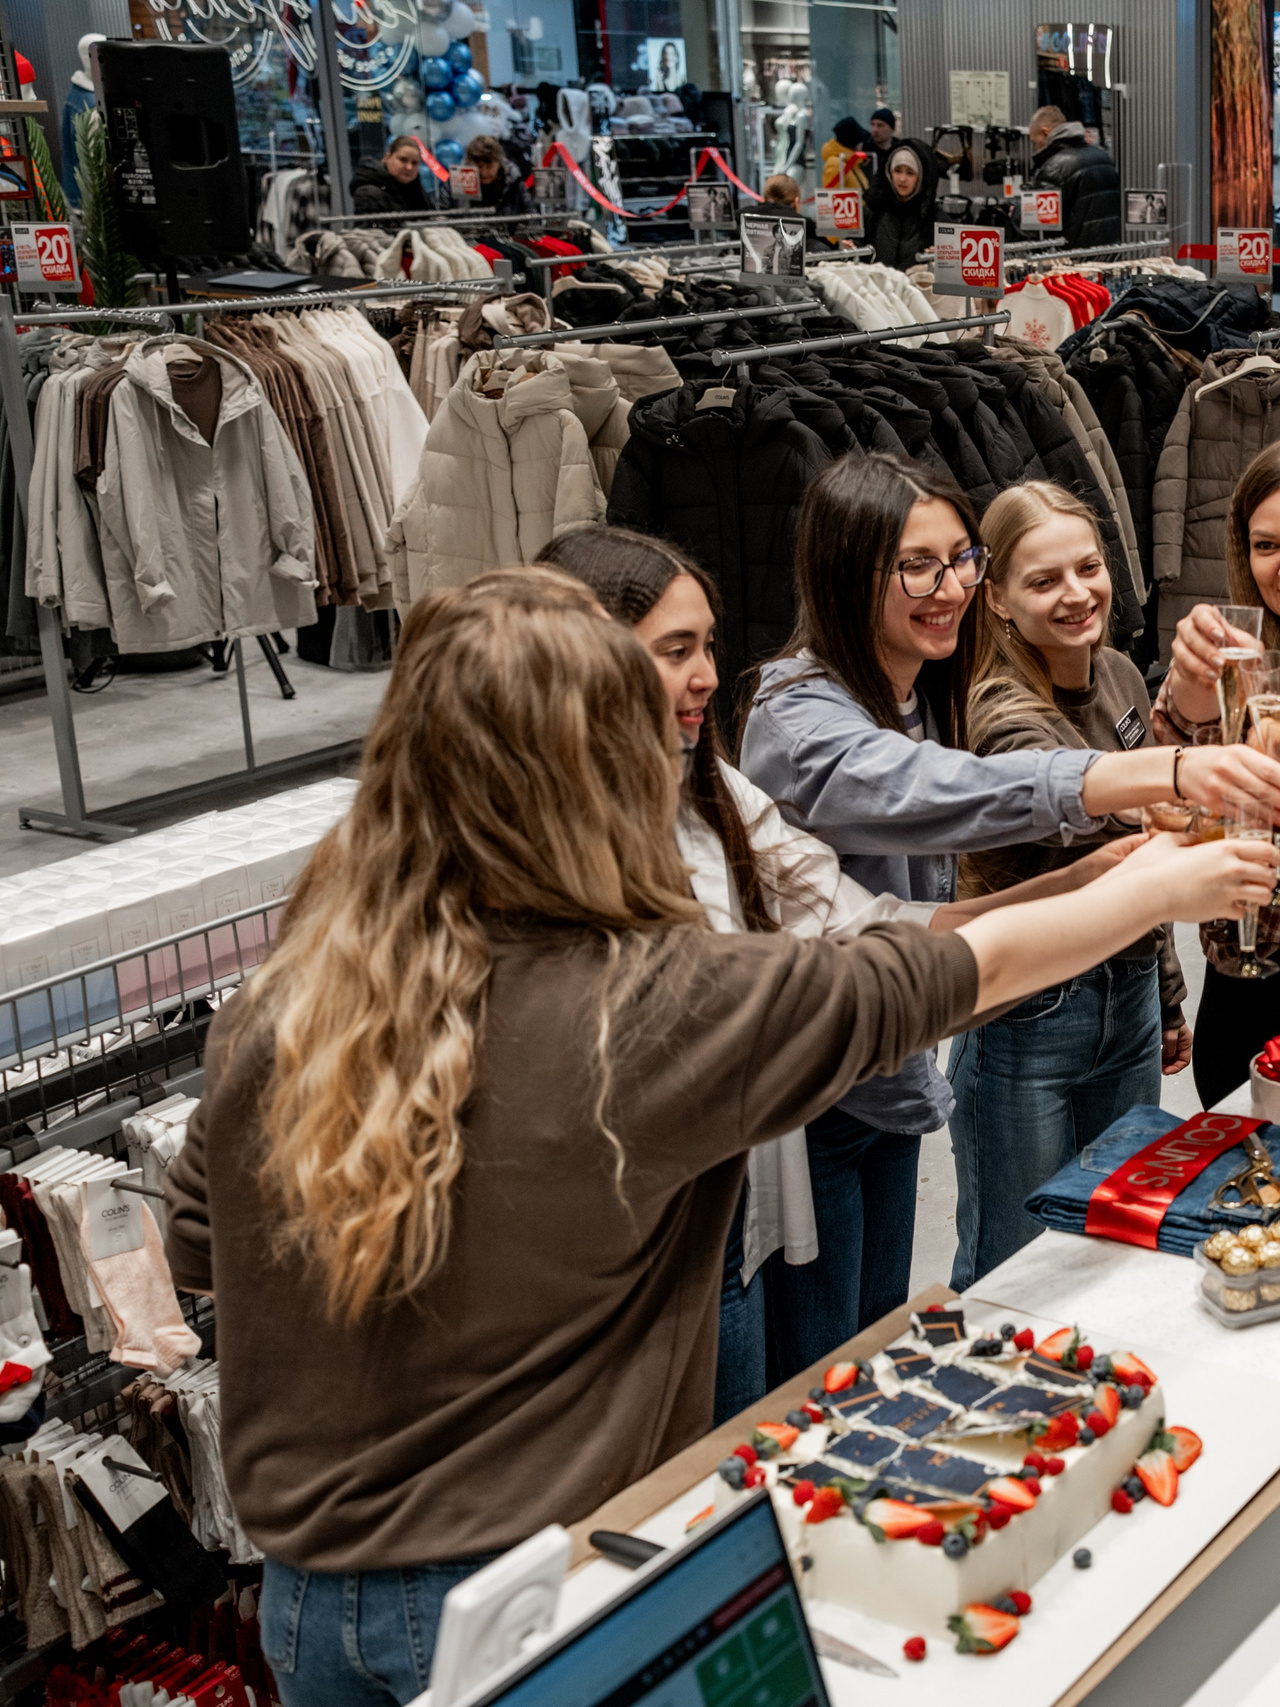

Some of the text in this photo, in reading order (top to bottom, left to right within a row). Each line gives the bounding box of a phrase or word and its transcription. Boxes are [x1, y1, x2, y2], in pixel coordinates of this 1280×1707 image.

[962, 237, 1000, 268] 20%
[42, 264, 71, 275] СКИДКА
[962, 268, 996, 278] СКИДКА
[1127, 1115, 1242, 1188] COLIN'S
